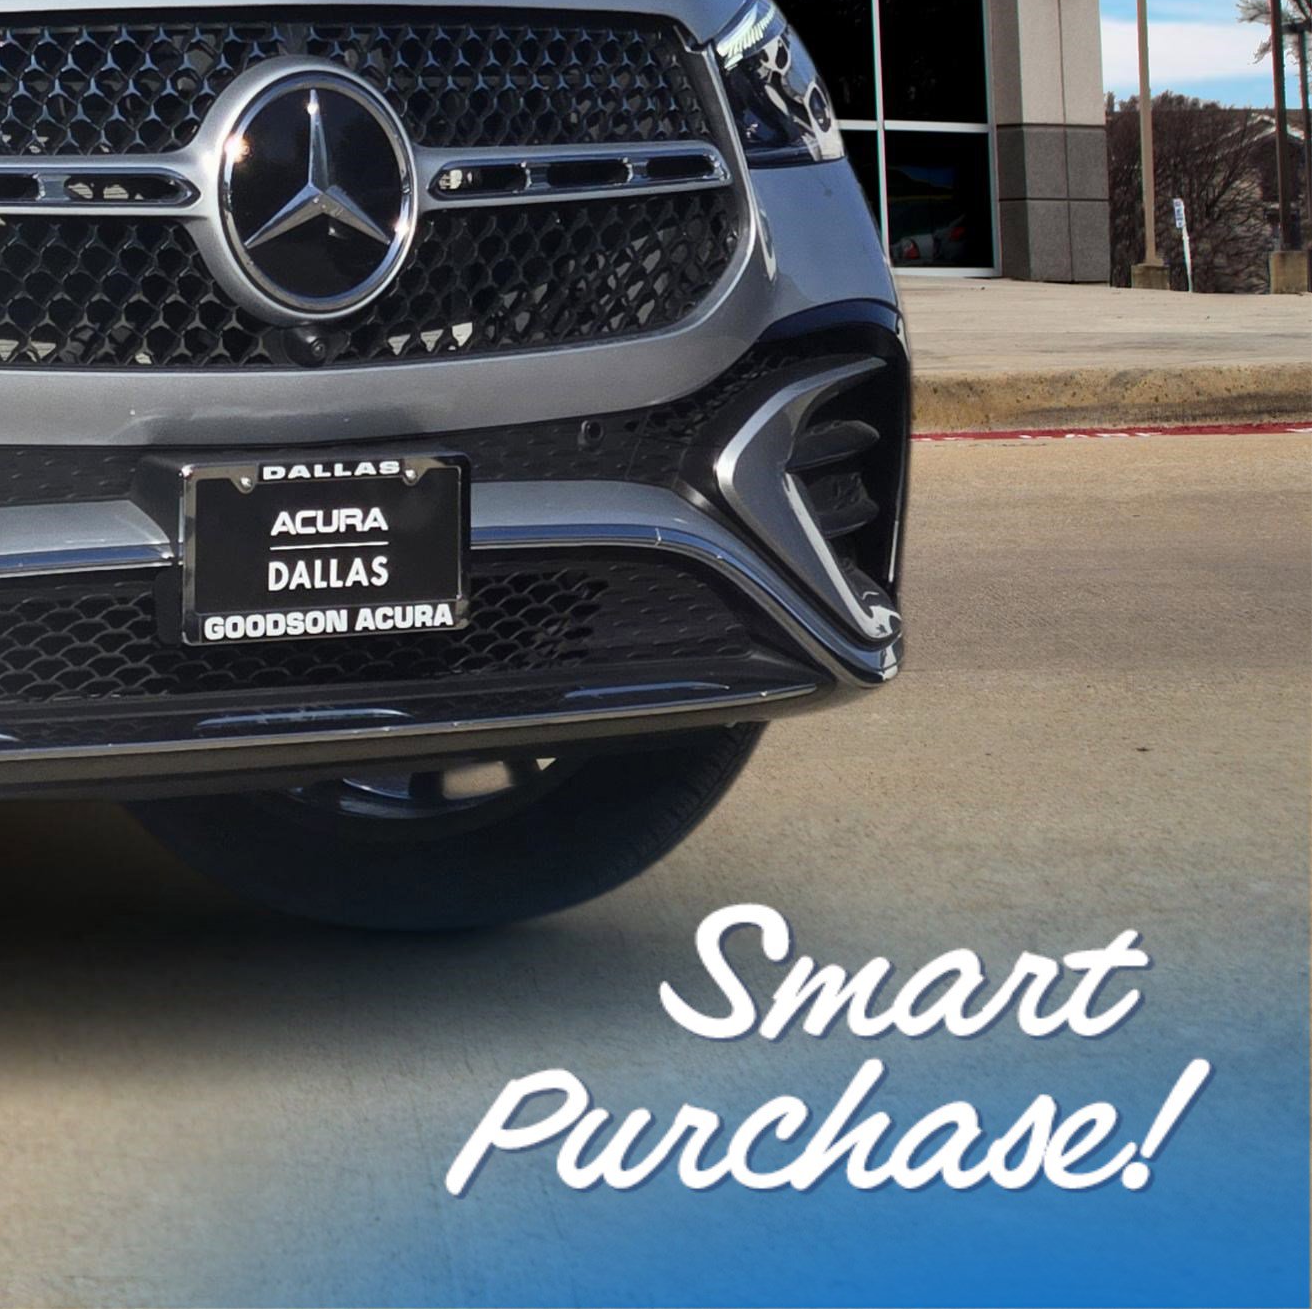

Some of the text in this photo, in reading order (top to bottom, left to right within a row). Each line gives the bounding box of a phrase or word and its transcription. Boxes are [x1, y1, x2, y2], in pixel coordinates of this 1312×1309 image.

[262, 460, 401, 481] DALLAS
[270, 506, 390, 537] ACURA
[267, 555, 390, 593] DALLAS
[203, 603, 454, 641] GOODSON ACURA
